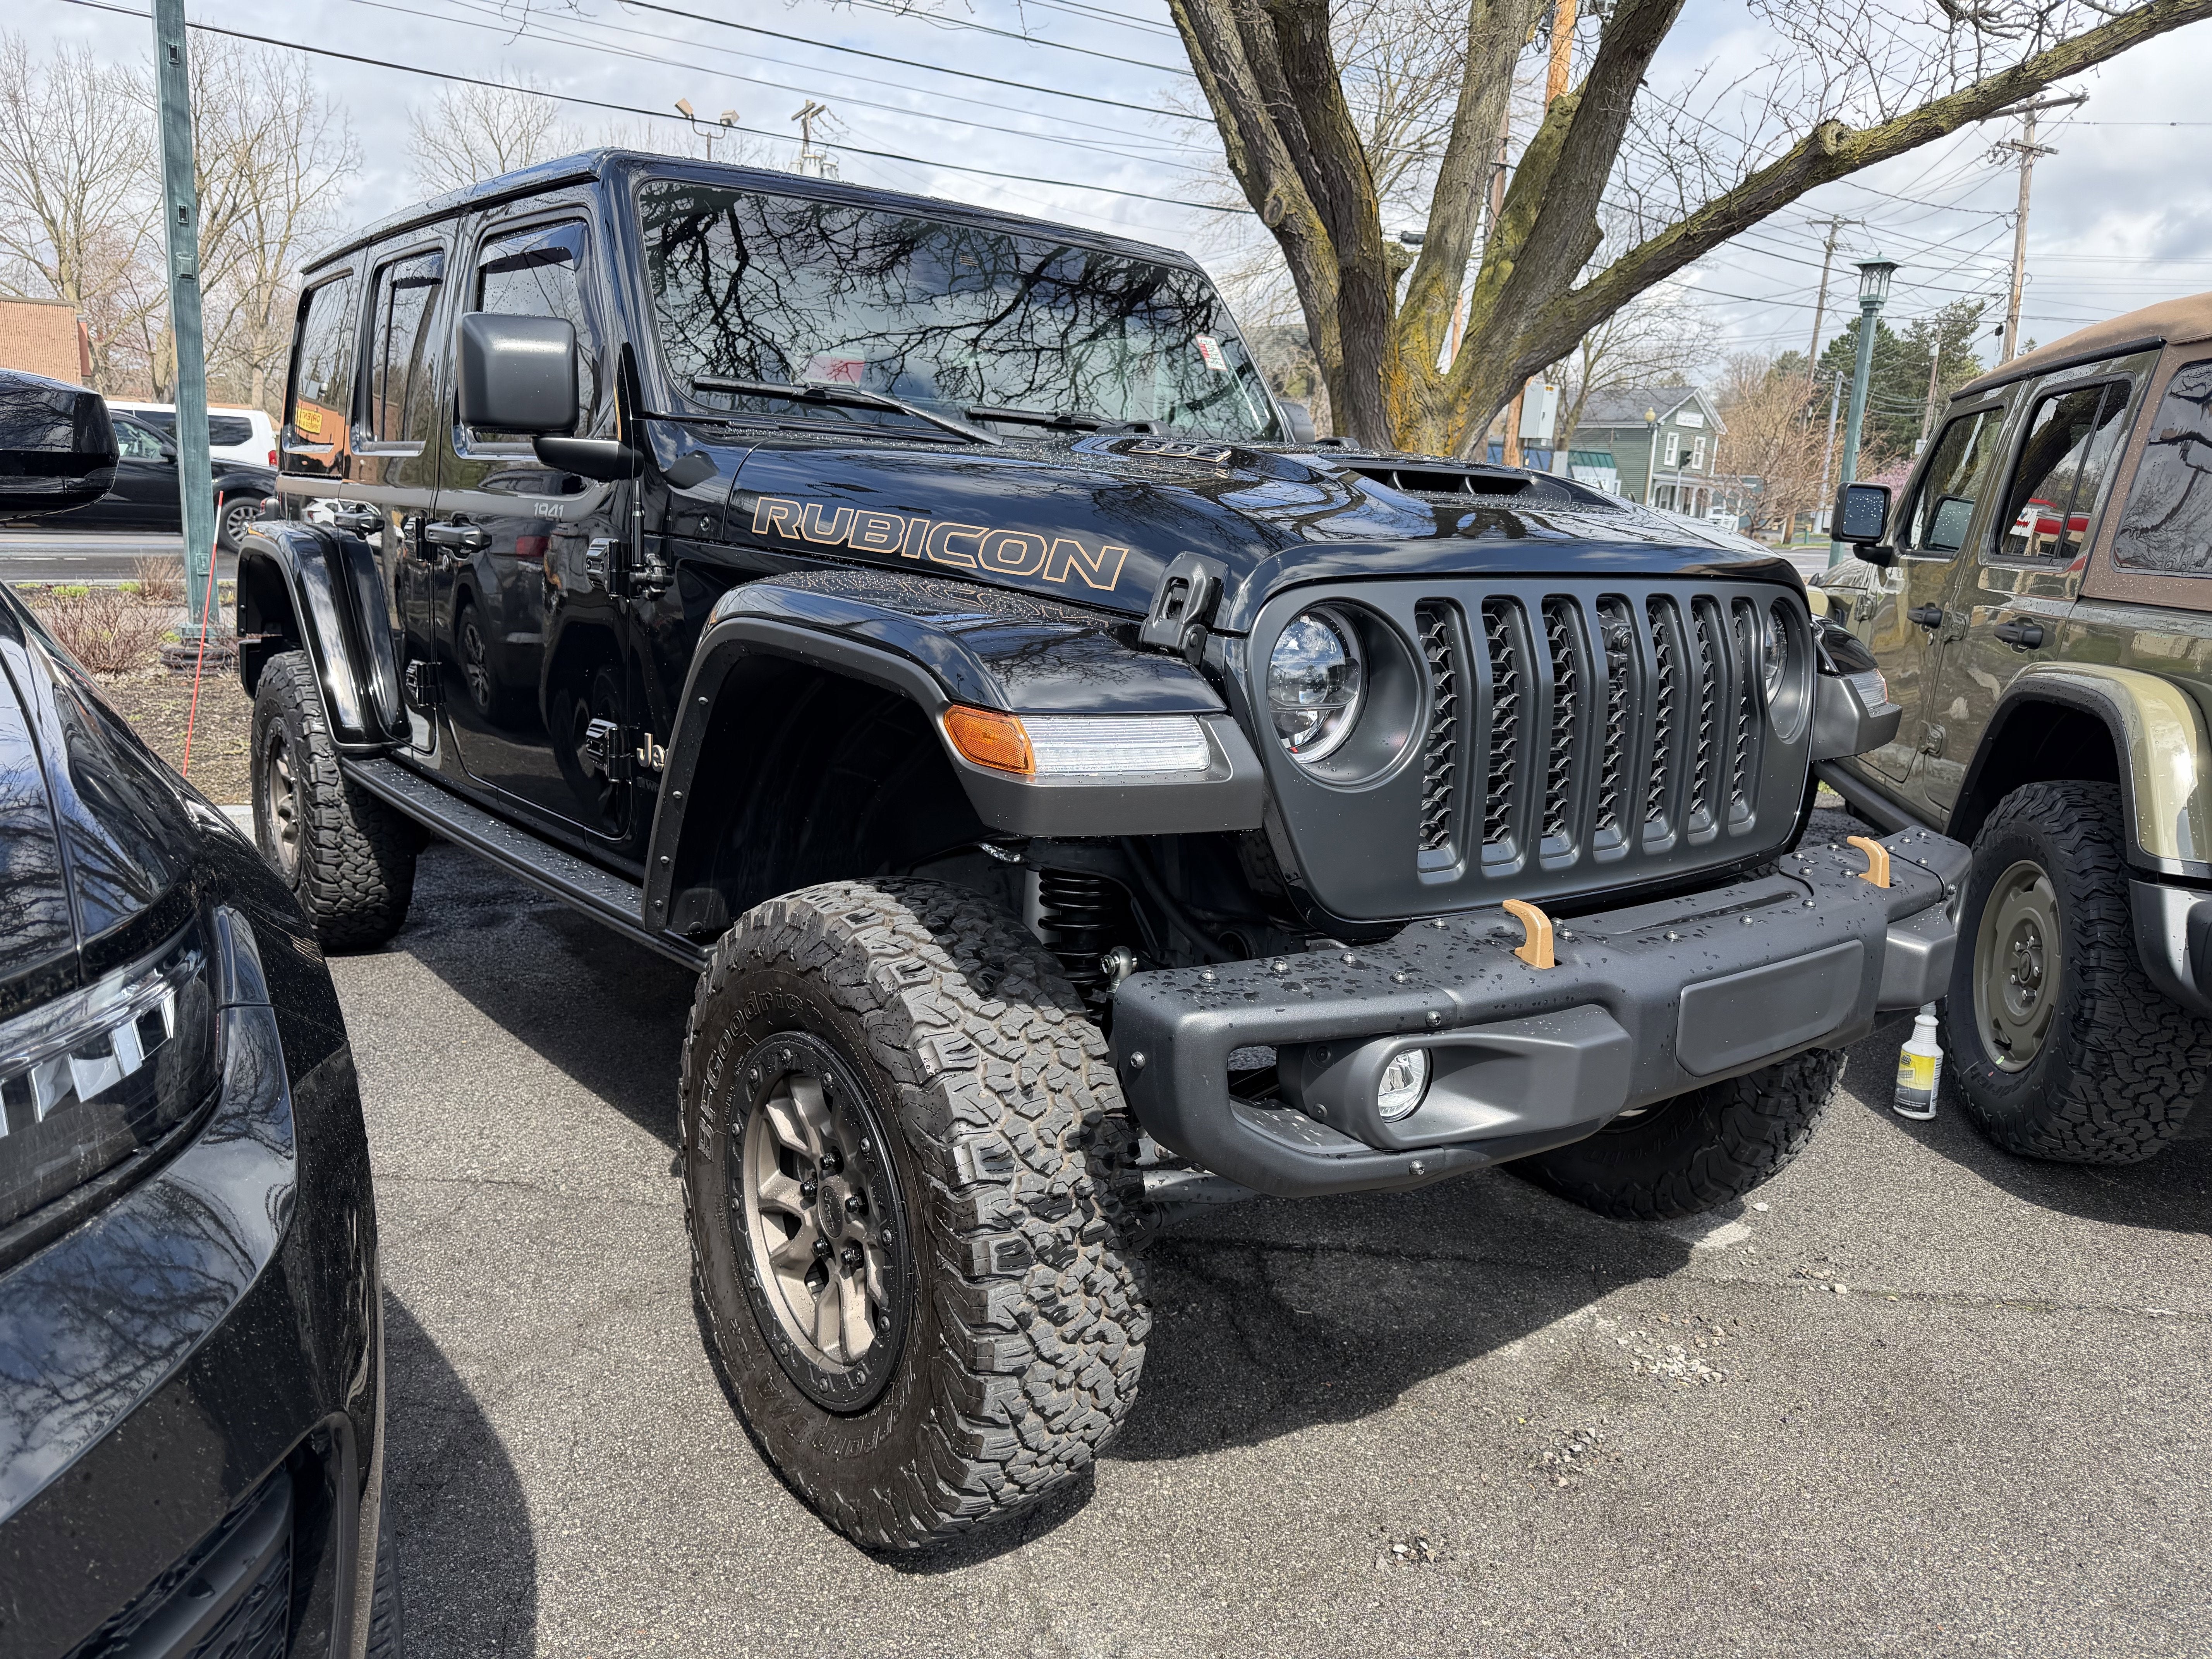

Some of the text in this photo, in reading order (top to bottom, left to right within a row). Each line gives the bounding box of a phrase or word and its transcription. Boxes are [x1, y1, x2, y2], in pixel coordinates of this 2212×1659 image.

[534, 502, 564, 518] 1941
[752, 496, 1129, 591] RUBICON
[636, 732, 668, 772] Je
[697, 986, 824, 1163] BFGoodrich
[824, 1192, 835, 1230] Jeep
